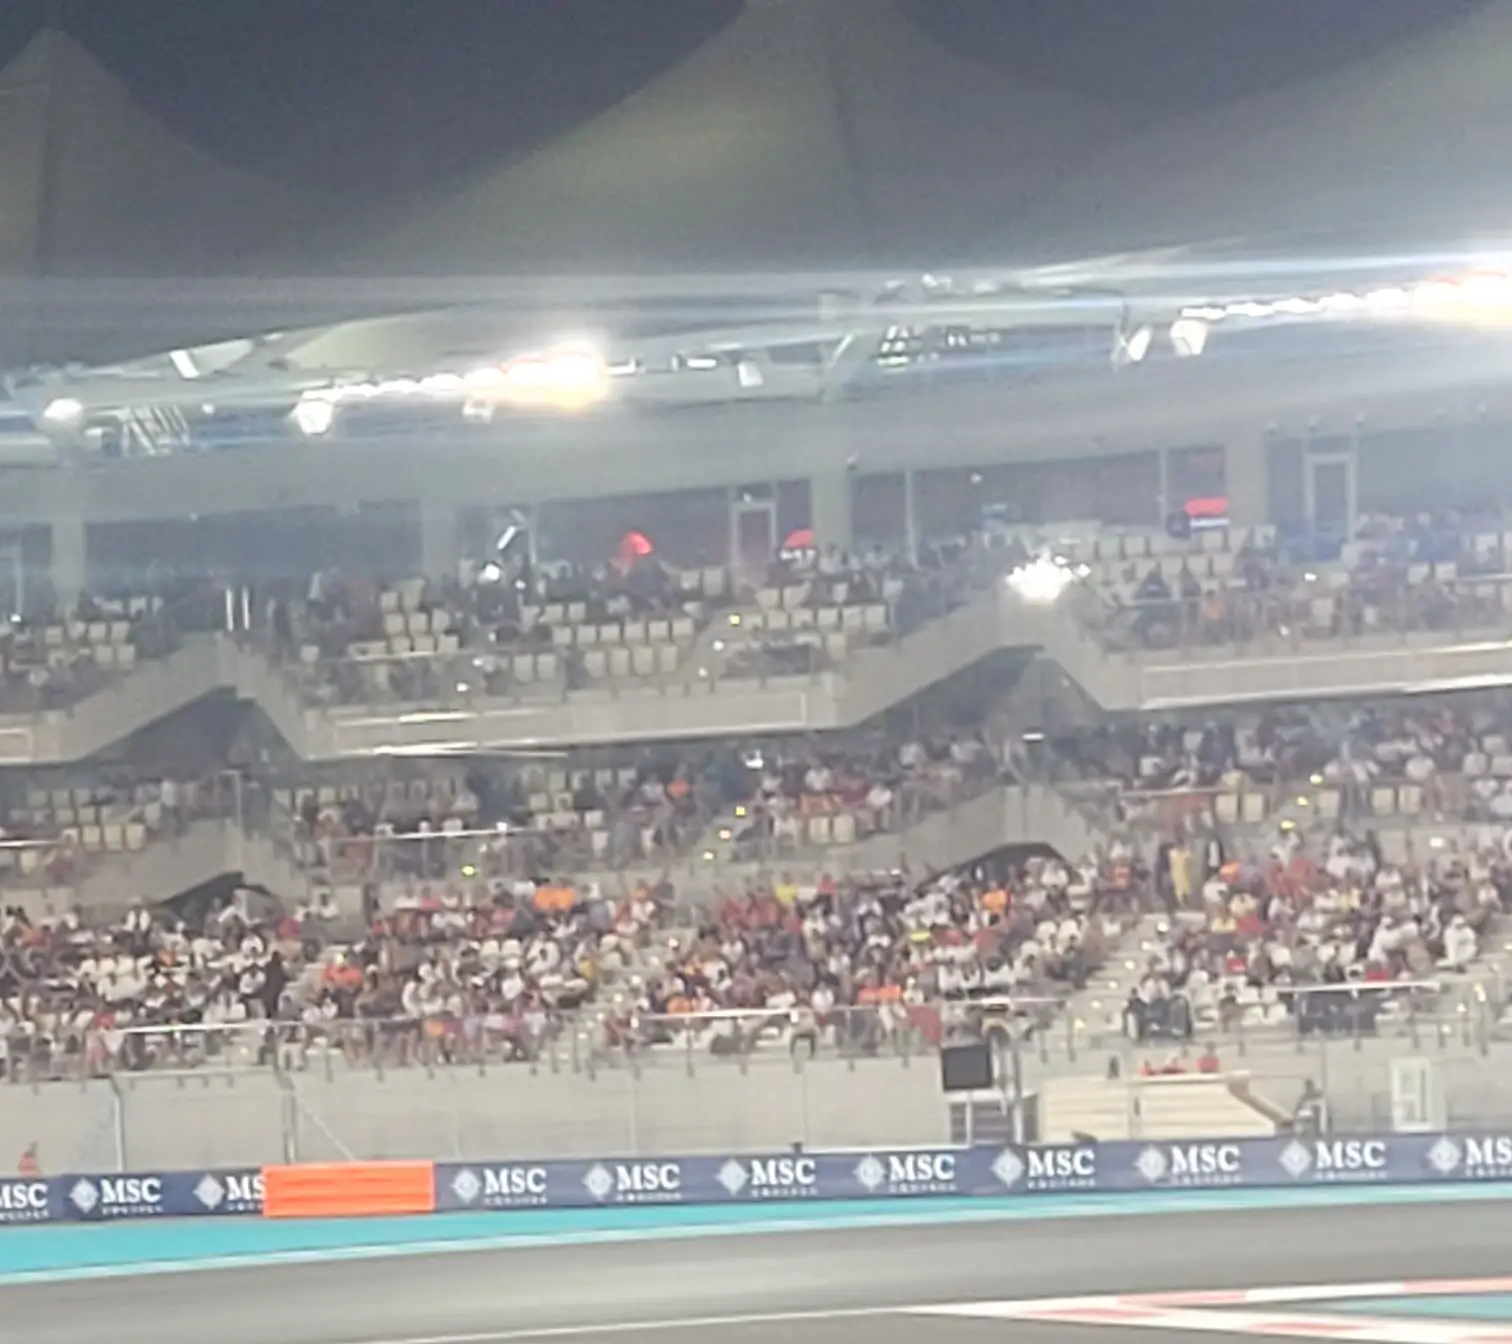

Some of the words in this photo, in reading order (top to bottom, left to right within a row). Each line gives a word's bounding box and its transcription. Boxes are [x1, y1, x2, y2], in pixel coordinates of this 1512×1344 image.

[1027, 1149, 1095, 1177] MSC
[1171, 1145, 1240, 1175] MSC
[1315, 1141, 1386, 1169] MSC
[1465, 1137, 1512, 1166] MS
[484, 1167, 546, 1195] MSC
[616, 1164, 680, 1191] MSC
[751, 1159, 815, 1186] MSC
[889, 1154, 955, 1182] MSC
[100, 1178, 161, 1204] MSC
[226, 1175, 265, 1201] MS
